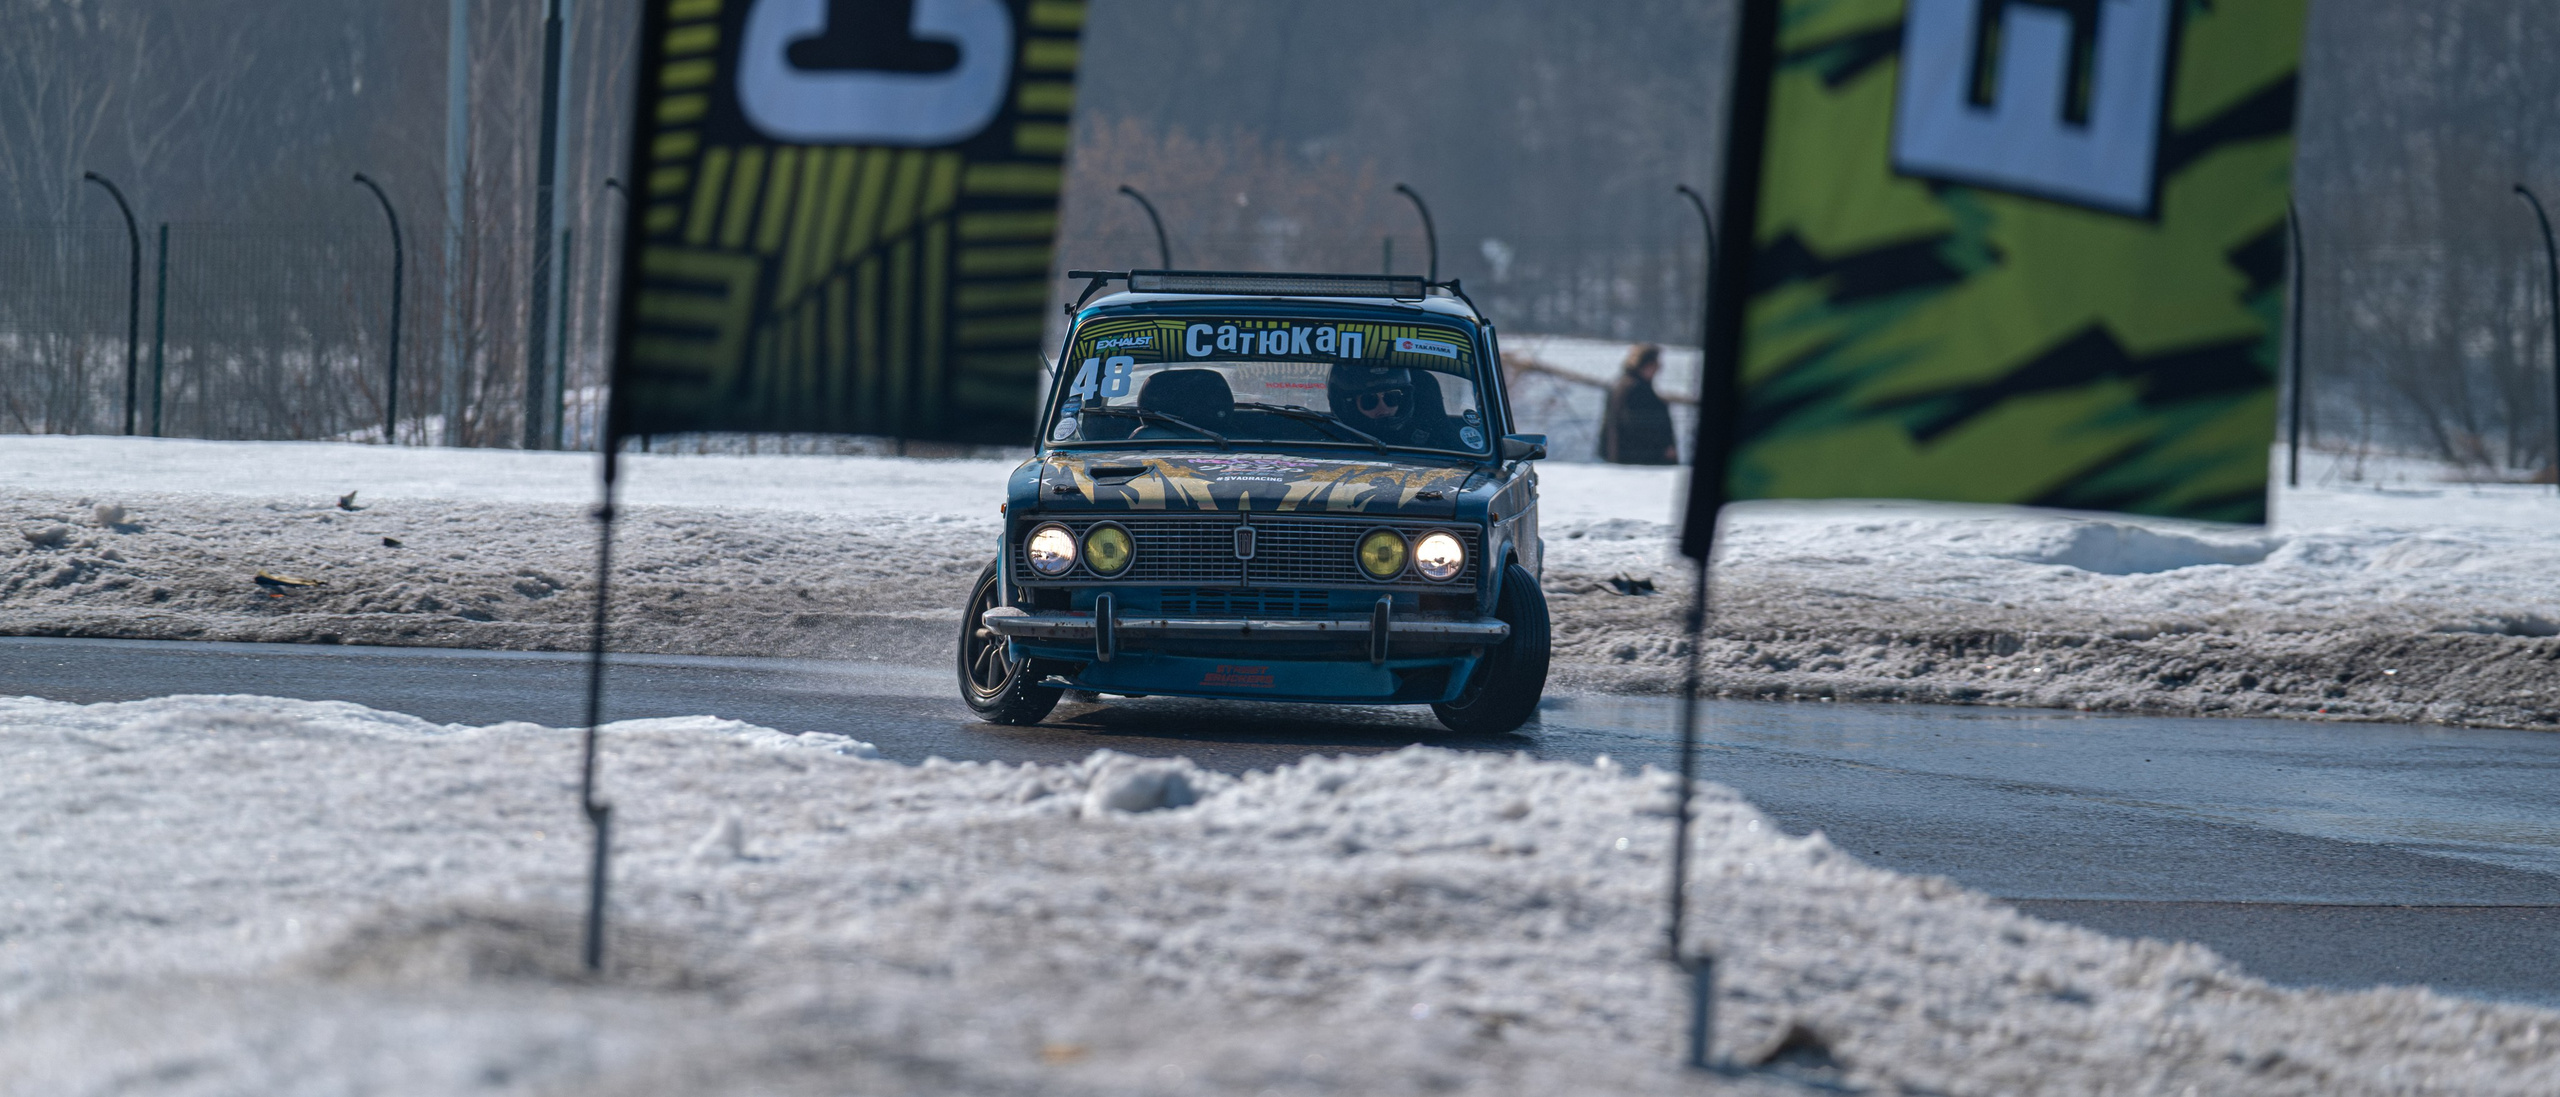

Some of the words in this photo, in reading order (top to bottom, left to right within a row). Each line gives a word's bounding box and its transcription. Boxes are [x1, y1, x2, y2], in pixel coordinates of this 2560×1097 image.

[1096, 336, 1153, 350] EXHAUST
[1414, 343, 1451, 354] TAKAYAMA
[1069, 355, 1135, 401] 48
